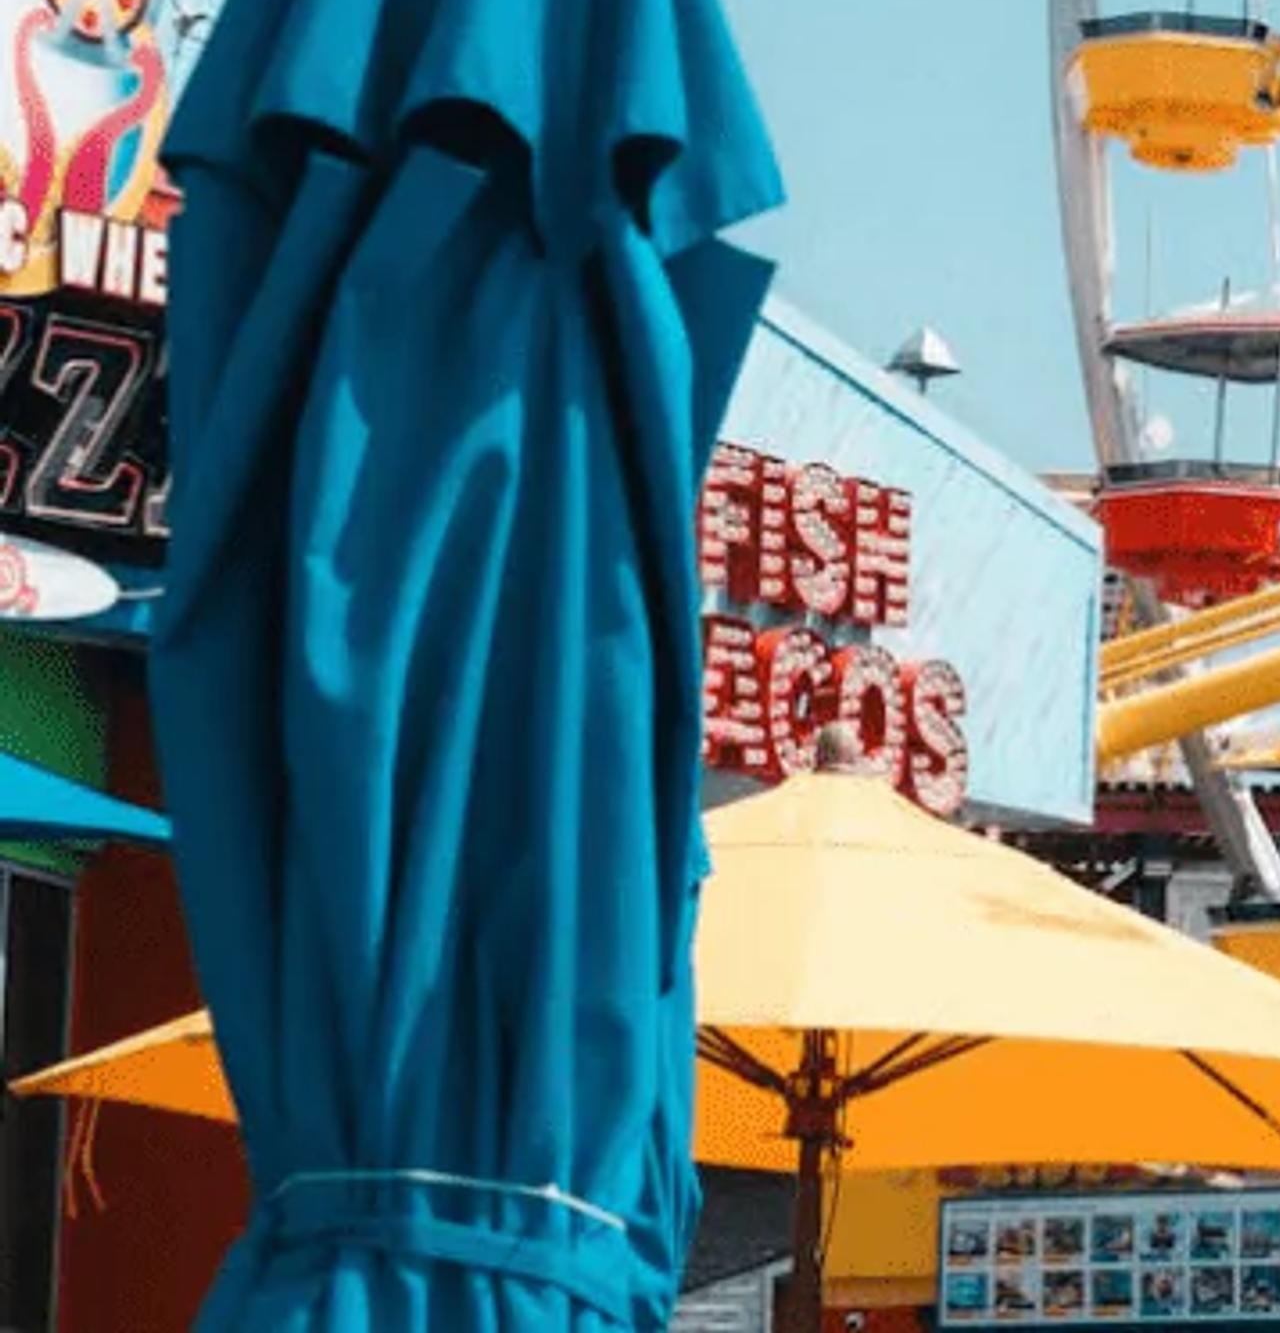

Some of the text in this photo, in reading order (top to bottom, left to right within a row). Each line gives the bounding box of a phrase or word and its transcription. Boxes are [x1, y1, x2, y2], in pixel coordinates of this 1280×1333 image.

[60, 209, 168, 305] WHE
[700, 444, 912, 628] FISH
[702, 616, 968, 816] ACOS
